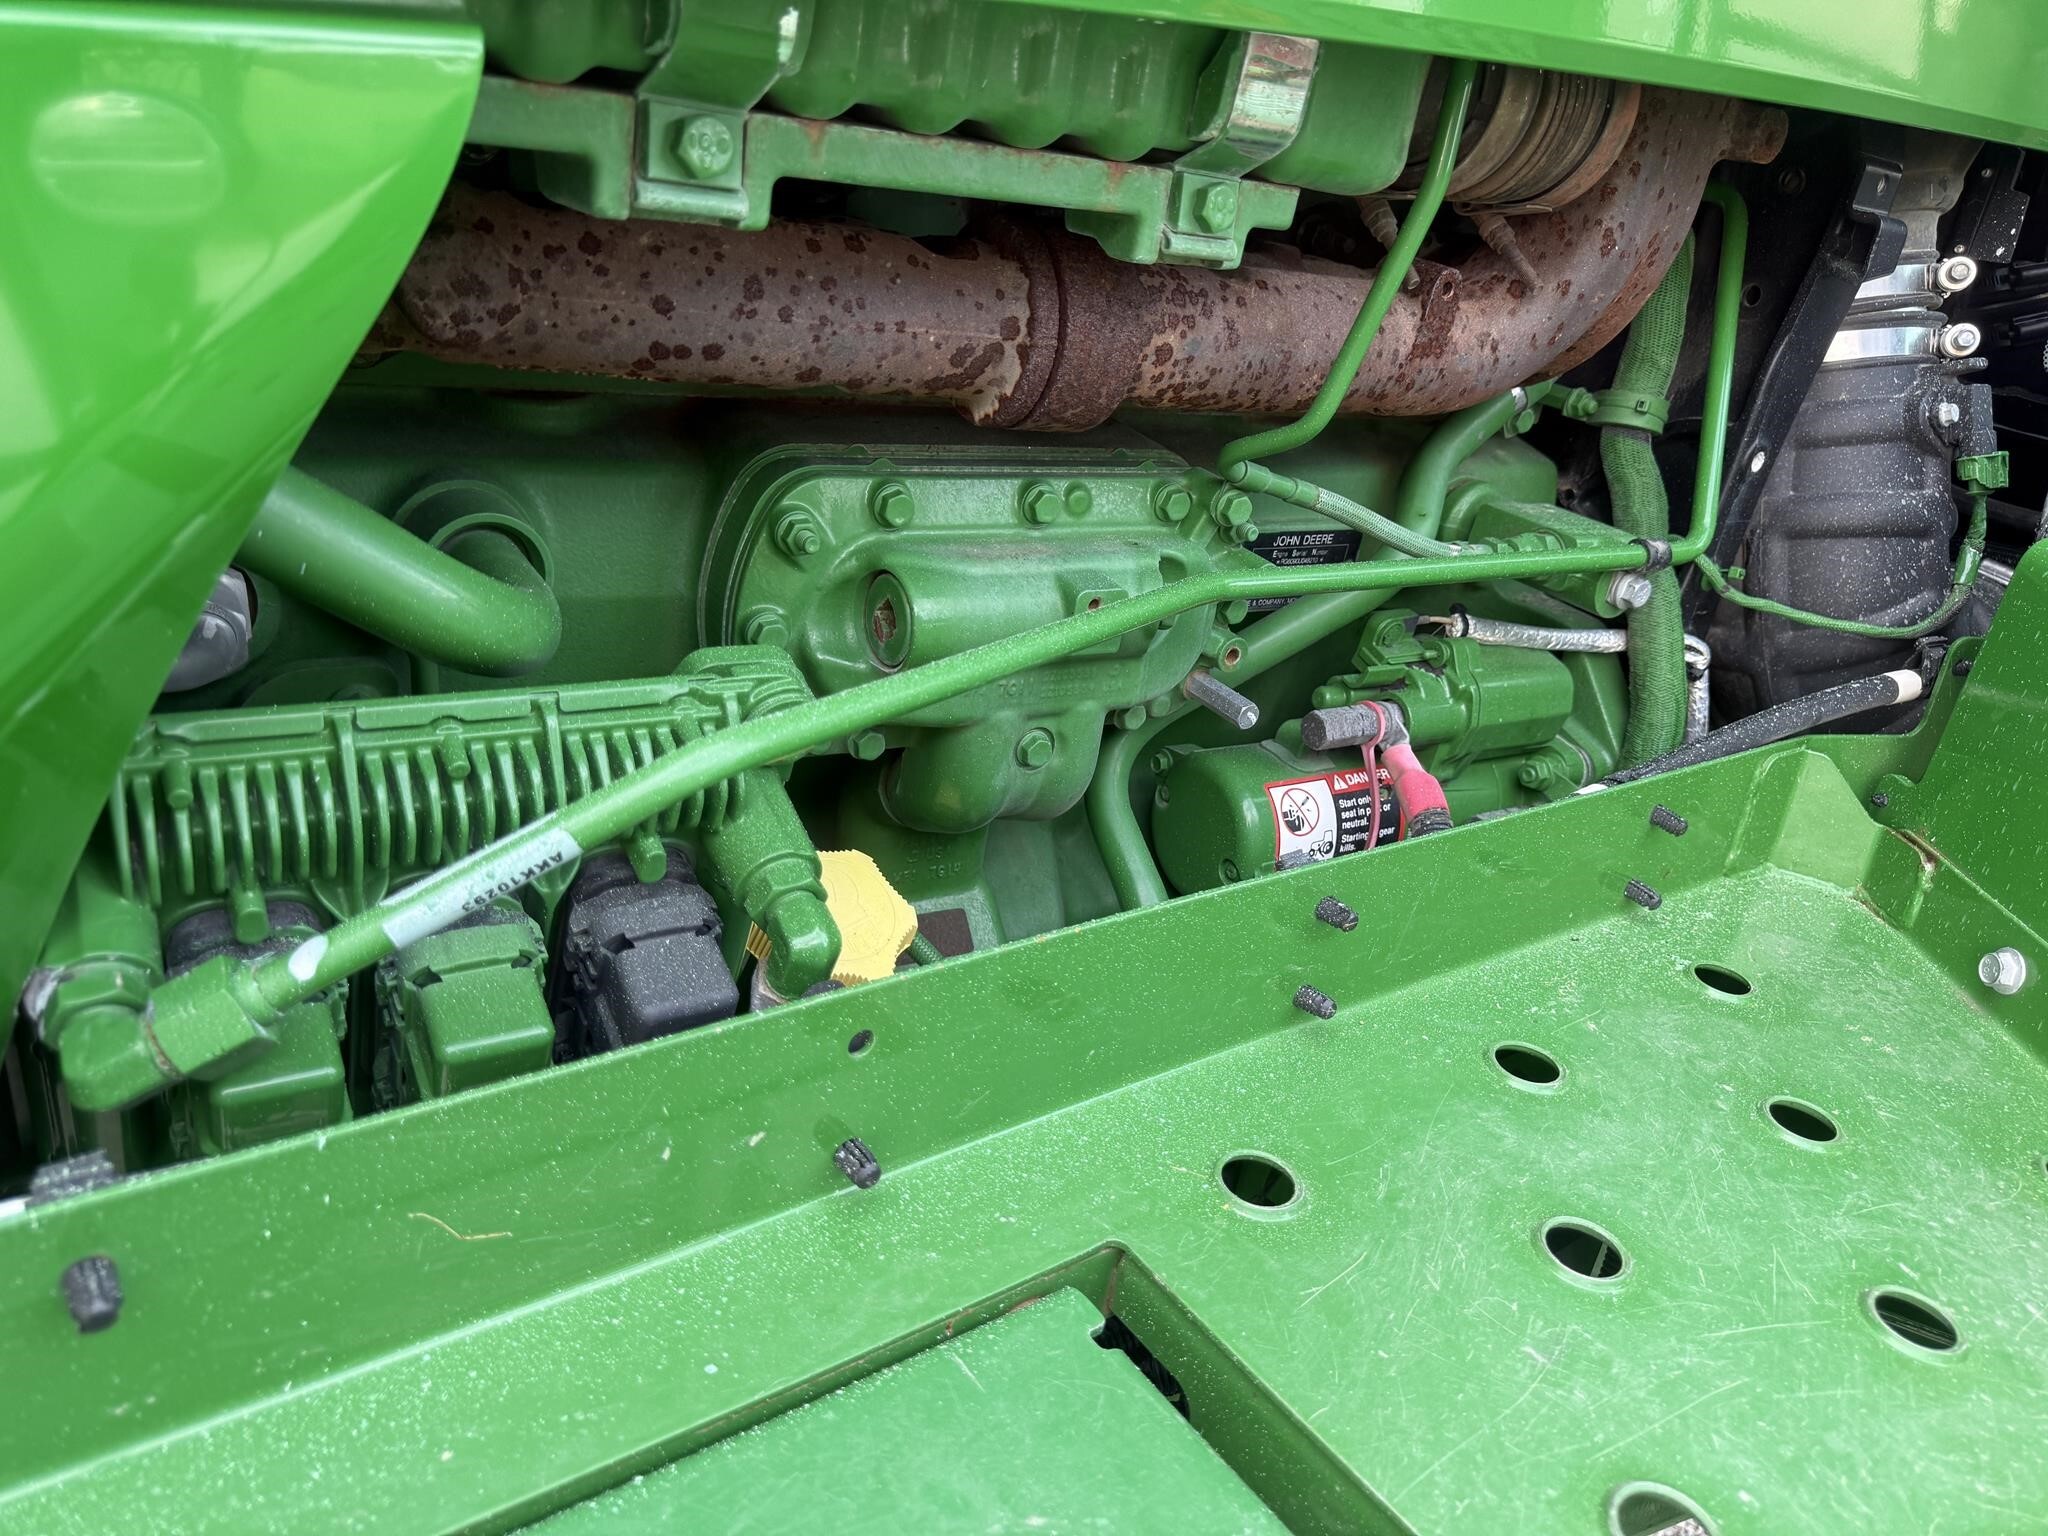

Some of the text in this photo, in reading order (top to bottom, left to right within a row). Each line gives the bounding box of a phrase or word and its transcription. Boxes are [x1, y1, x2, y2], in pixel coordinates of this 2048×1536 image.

[1273, 534, 1334, 546] JOHN DEERE
[1345, 769, 1391, 785] DANER
[1339, 798, 1357, 808] Start
[1341, 809, 1357, 819] seat
[1358, 808, 1365, 816] in
[1383, 804, 1391, 812] or
[1342, 817, 1369, 829] neutral.
[1379, 827, 1395, 837] gear
[1339, 843, 1356, 852] kills.
